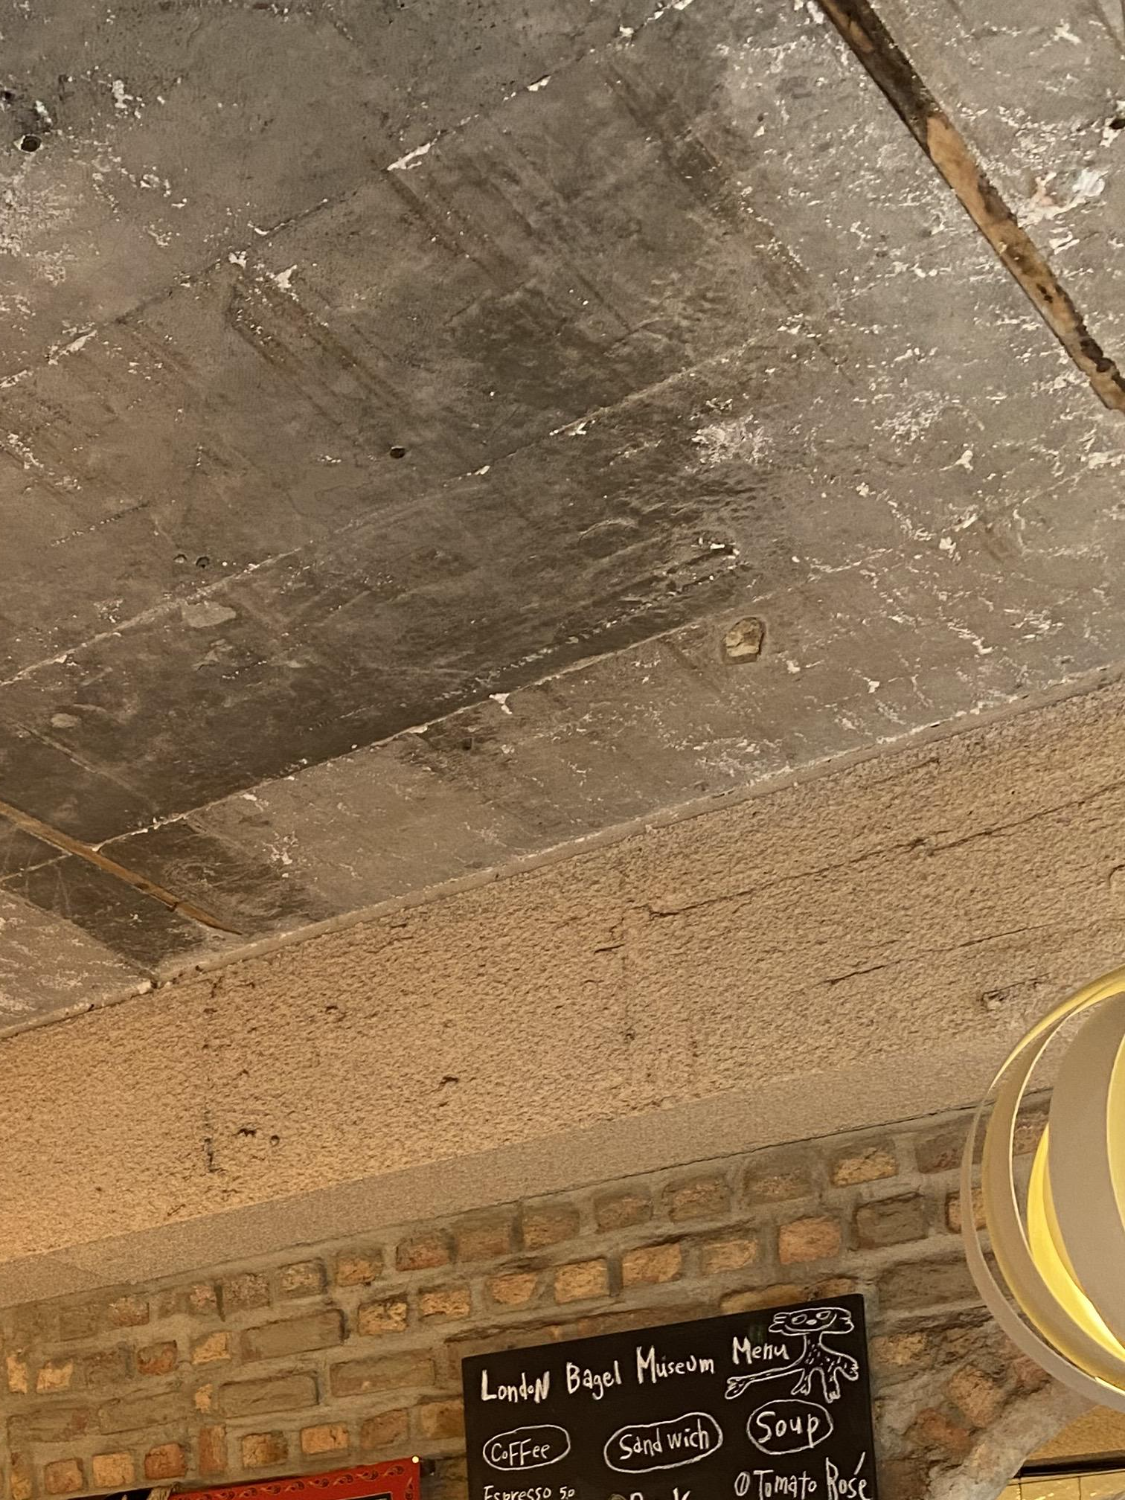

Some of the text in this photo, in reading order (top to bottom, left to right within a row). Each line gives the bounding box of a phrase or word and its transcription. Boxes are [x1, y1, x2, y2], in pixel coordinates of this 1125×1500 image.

[566, 1360, 622, 1400] Bagel
[636, 1345, 715, 1385] Museum
[732, 1336, 790, 1365] Menu
[756, 1411, 820, 1448] Soup
[559, 1486, 575, 1500] 5.0
